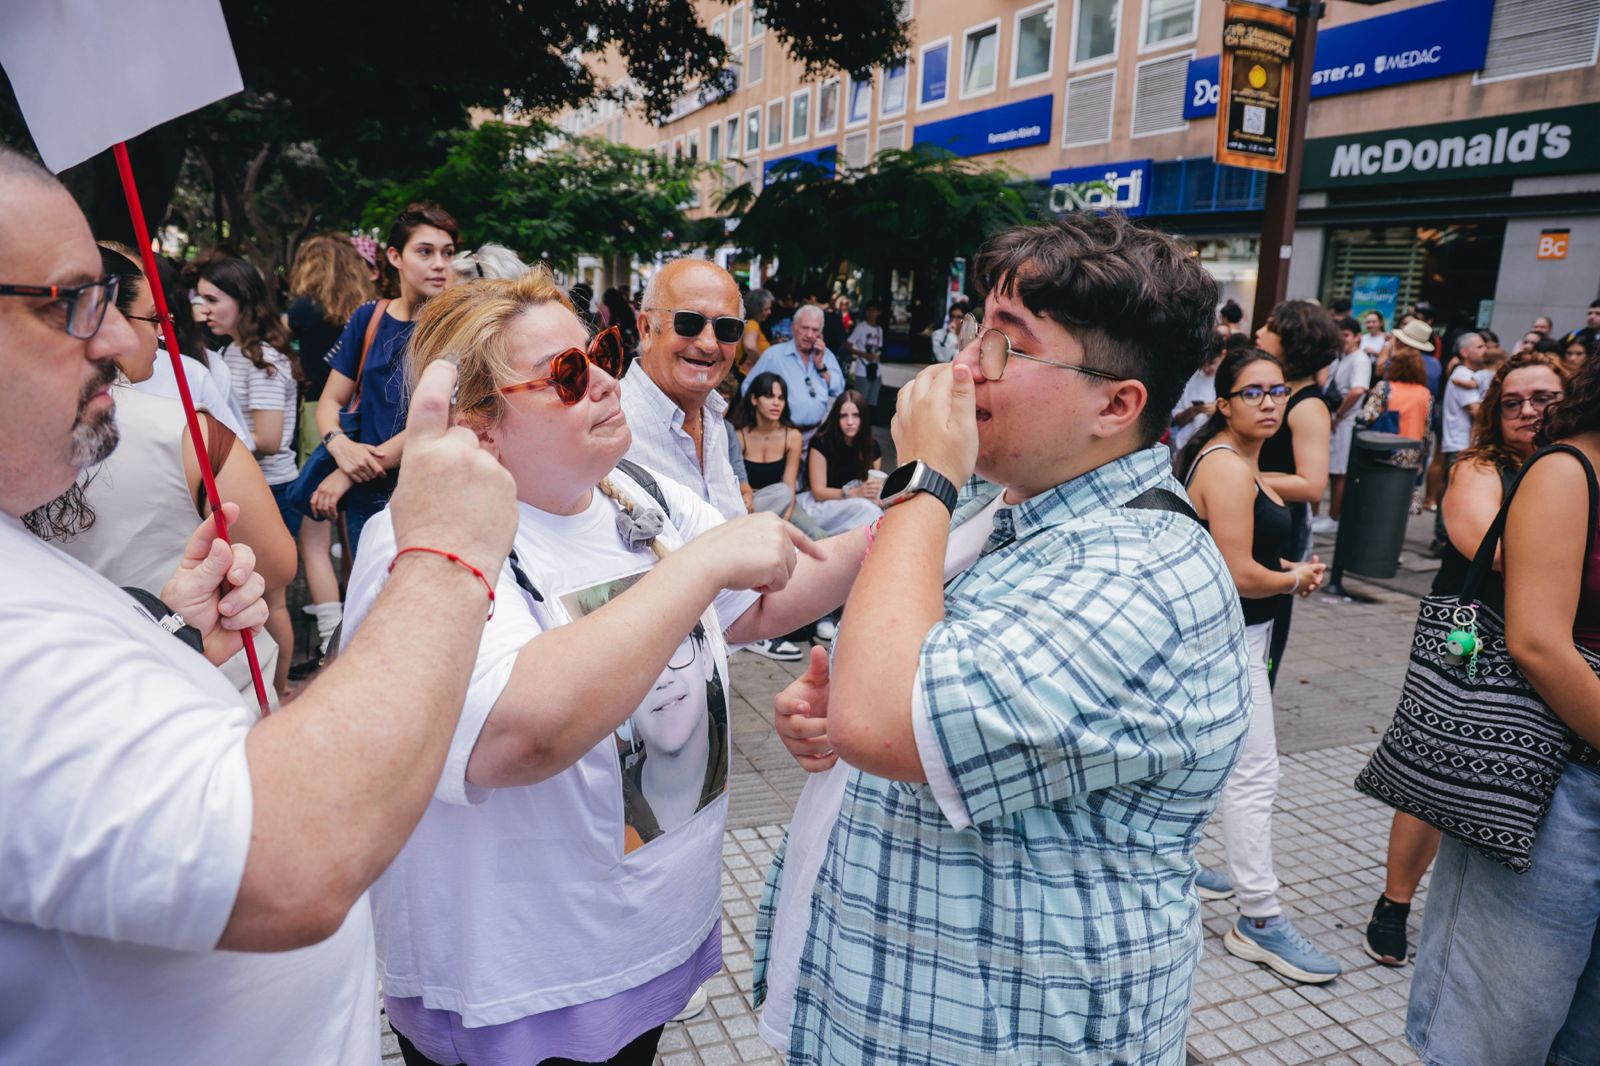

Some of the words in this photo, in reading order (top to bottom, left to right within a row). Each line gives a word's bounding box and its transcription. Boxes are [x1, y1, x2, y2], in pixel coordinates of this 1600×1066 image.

[1386, 45, 1441, 71] MEDAC
[1330, 122, 1572, 177] McDonald's
[1538, 237, 1567, 257] Bc
